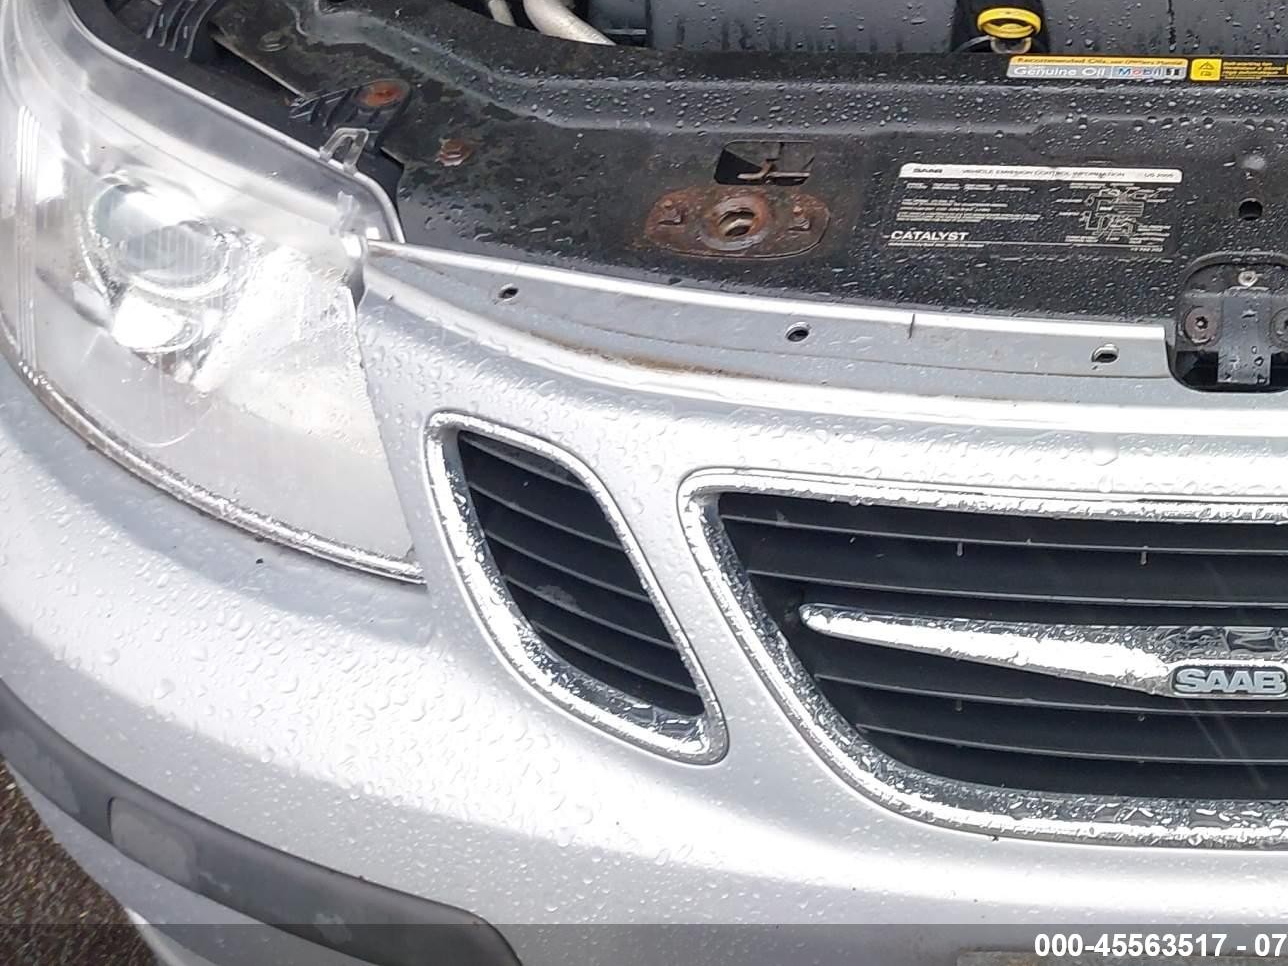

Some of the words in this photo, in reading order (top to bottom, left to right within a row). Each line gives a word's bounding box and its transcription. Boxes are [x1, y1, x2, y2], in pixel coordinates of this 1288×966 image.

[1014, 66, 1077, 76] Genuine
[1082, 66, 1105, 76] Oil
[1118, 67, 1162, 77] Mobil
[891, 230, 969, 241] CATALYST
[1174, 668, 1287, 694] SAAB
